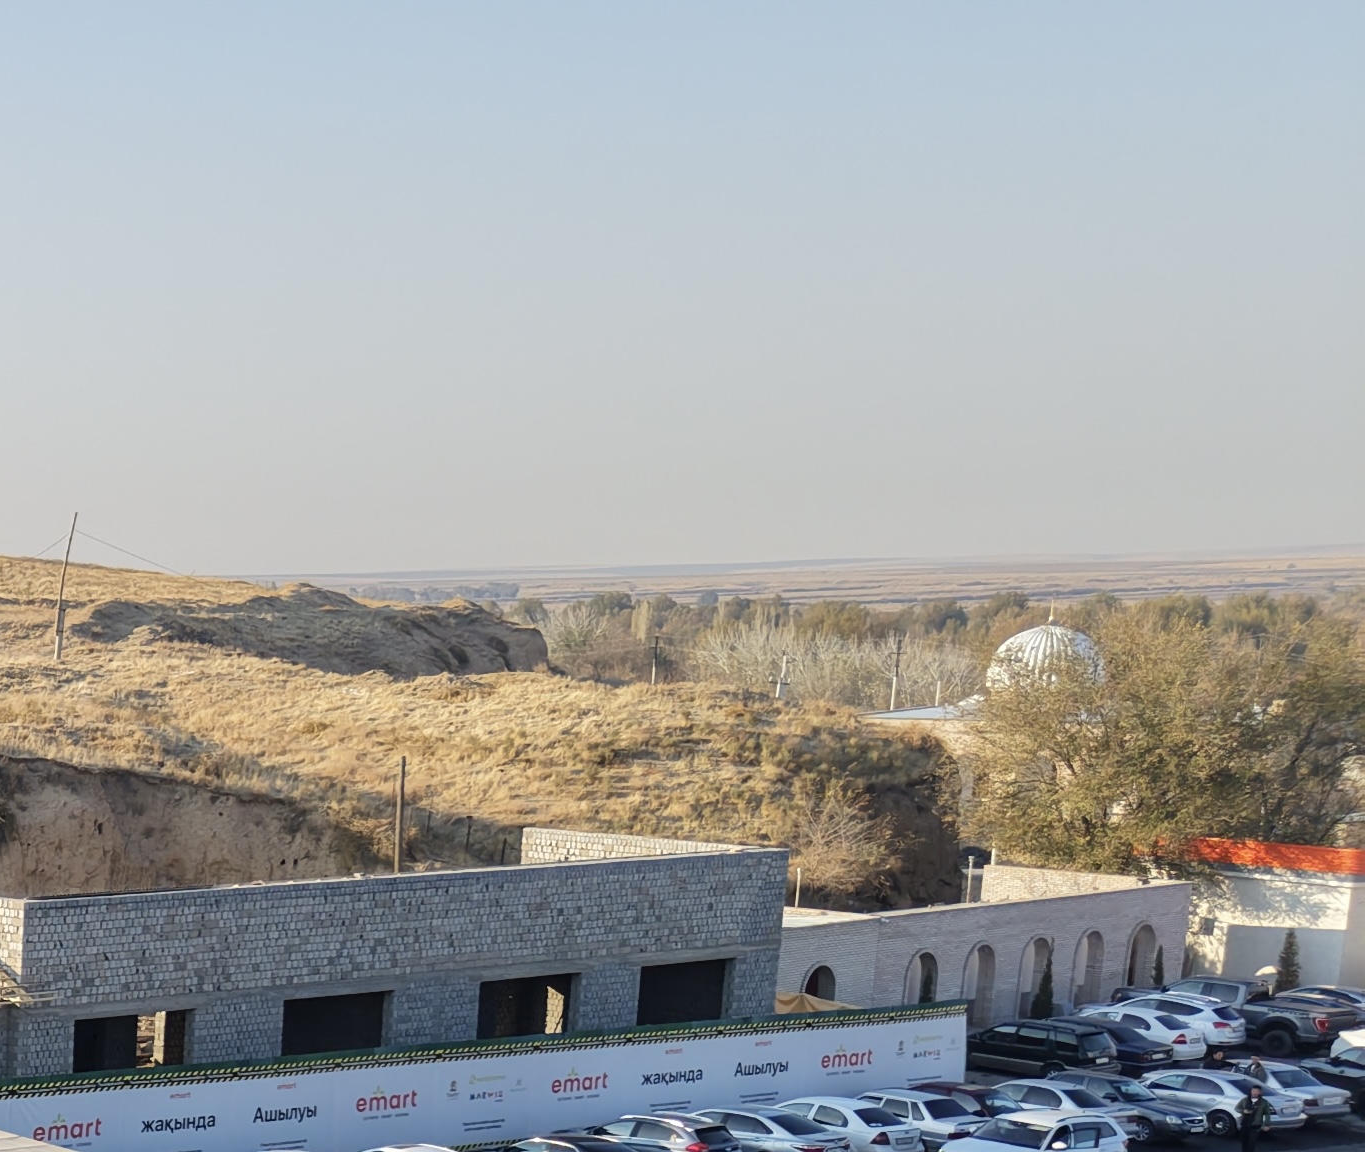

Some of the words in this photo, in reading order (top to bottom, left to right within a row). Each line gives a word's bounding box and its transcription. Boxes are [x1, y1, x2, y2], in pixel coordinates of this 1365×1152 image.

[821, 1048, 873, 1068] emart
[641, 1068, 703, 1086] жақында
[734, 1061, 789, 1077] Ашылуы
[551, 1072, 608, 1094] emart
[356, 1090, 418, 1112] emart
[253, 1105, 317, 1123] Ашылуы
[33, 1118, 102, 1142] emart
[141, 1115, 216, 1134] жақында
